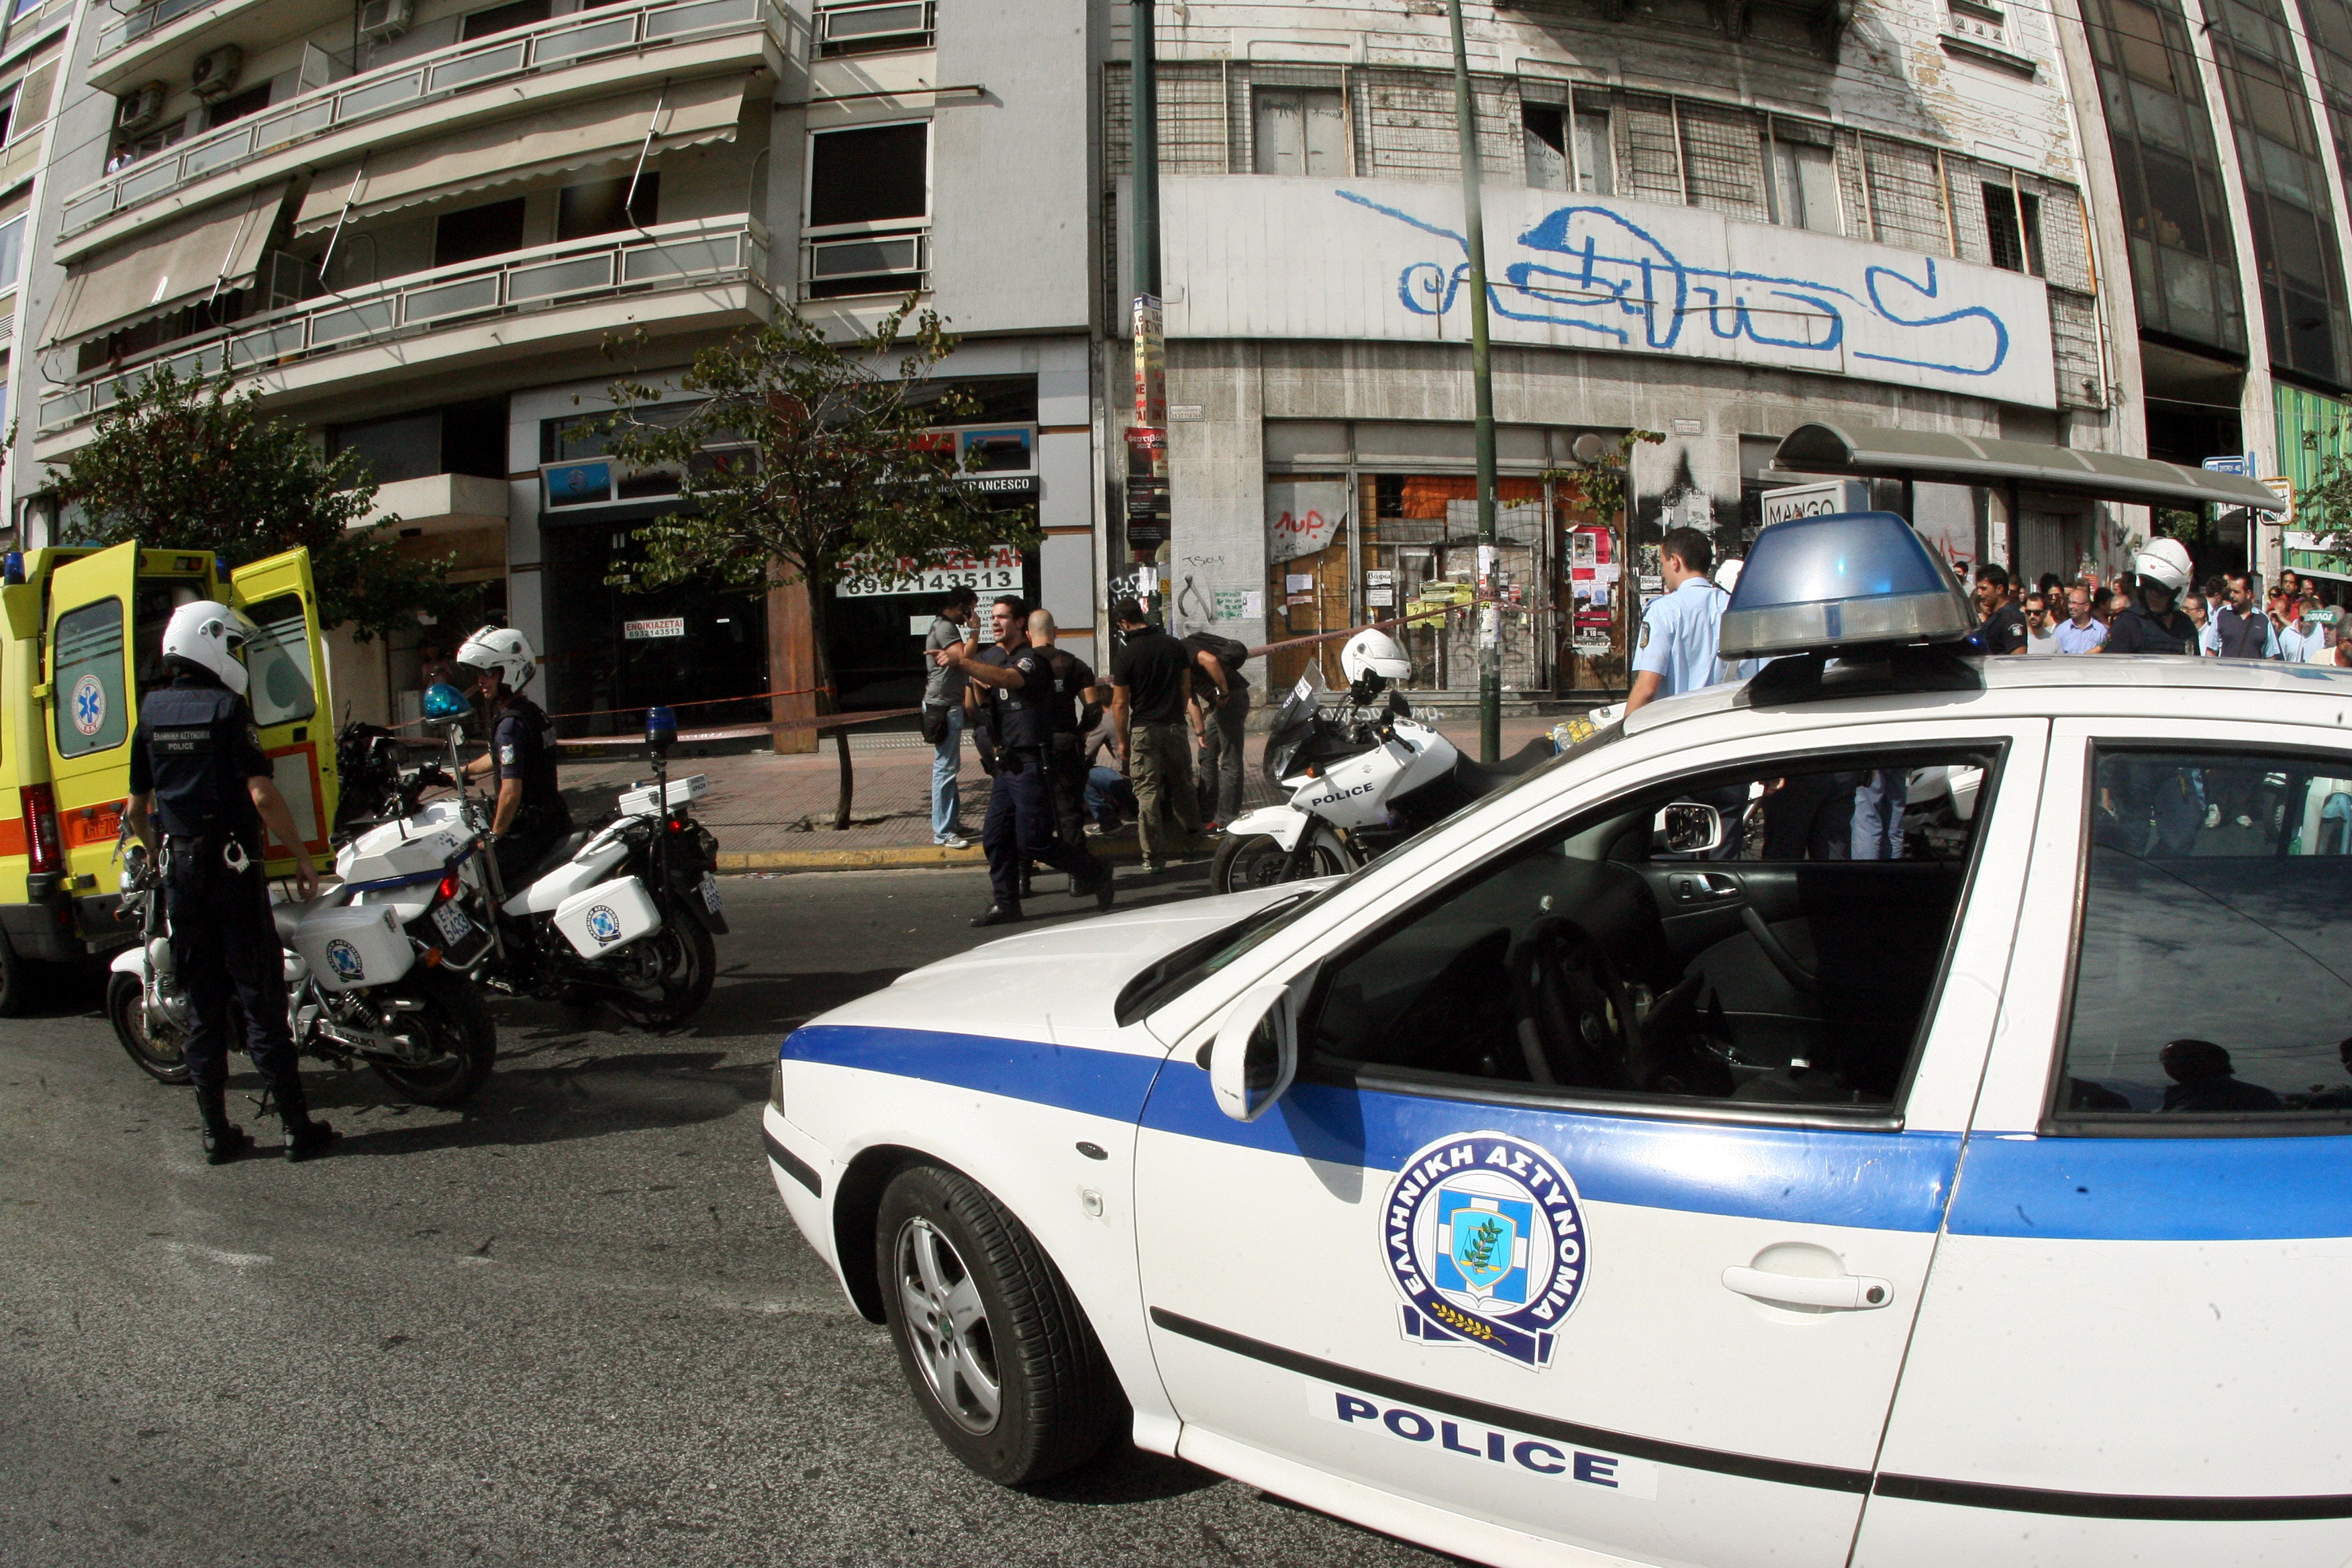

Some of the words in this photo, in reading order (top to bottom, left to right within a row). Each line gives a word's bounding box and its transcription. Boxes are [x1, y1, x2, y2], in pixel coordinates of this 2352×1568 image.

[630, 628, 680, 638] 6932143513
[168, 742, 194, 750] POLICE
[1312, 783, 1374, 806] POLICE
[444, 913, 469, 941] 5433
[336, 1029, 376, 1047] SUZUKI
[1390, 1144, 1474, 1296] ΕΛΛΗΝΙΚΗ
[1485, 1146, 1580, 1320] ΑΣΤΥΝΟΜΙΑ
[1334, 1391, 1619, 1489] POLICE
